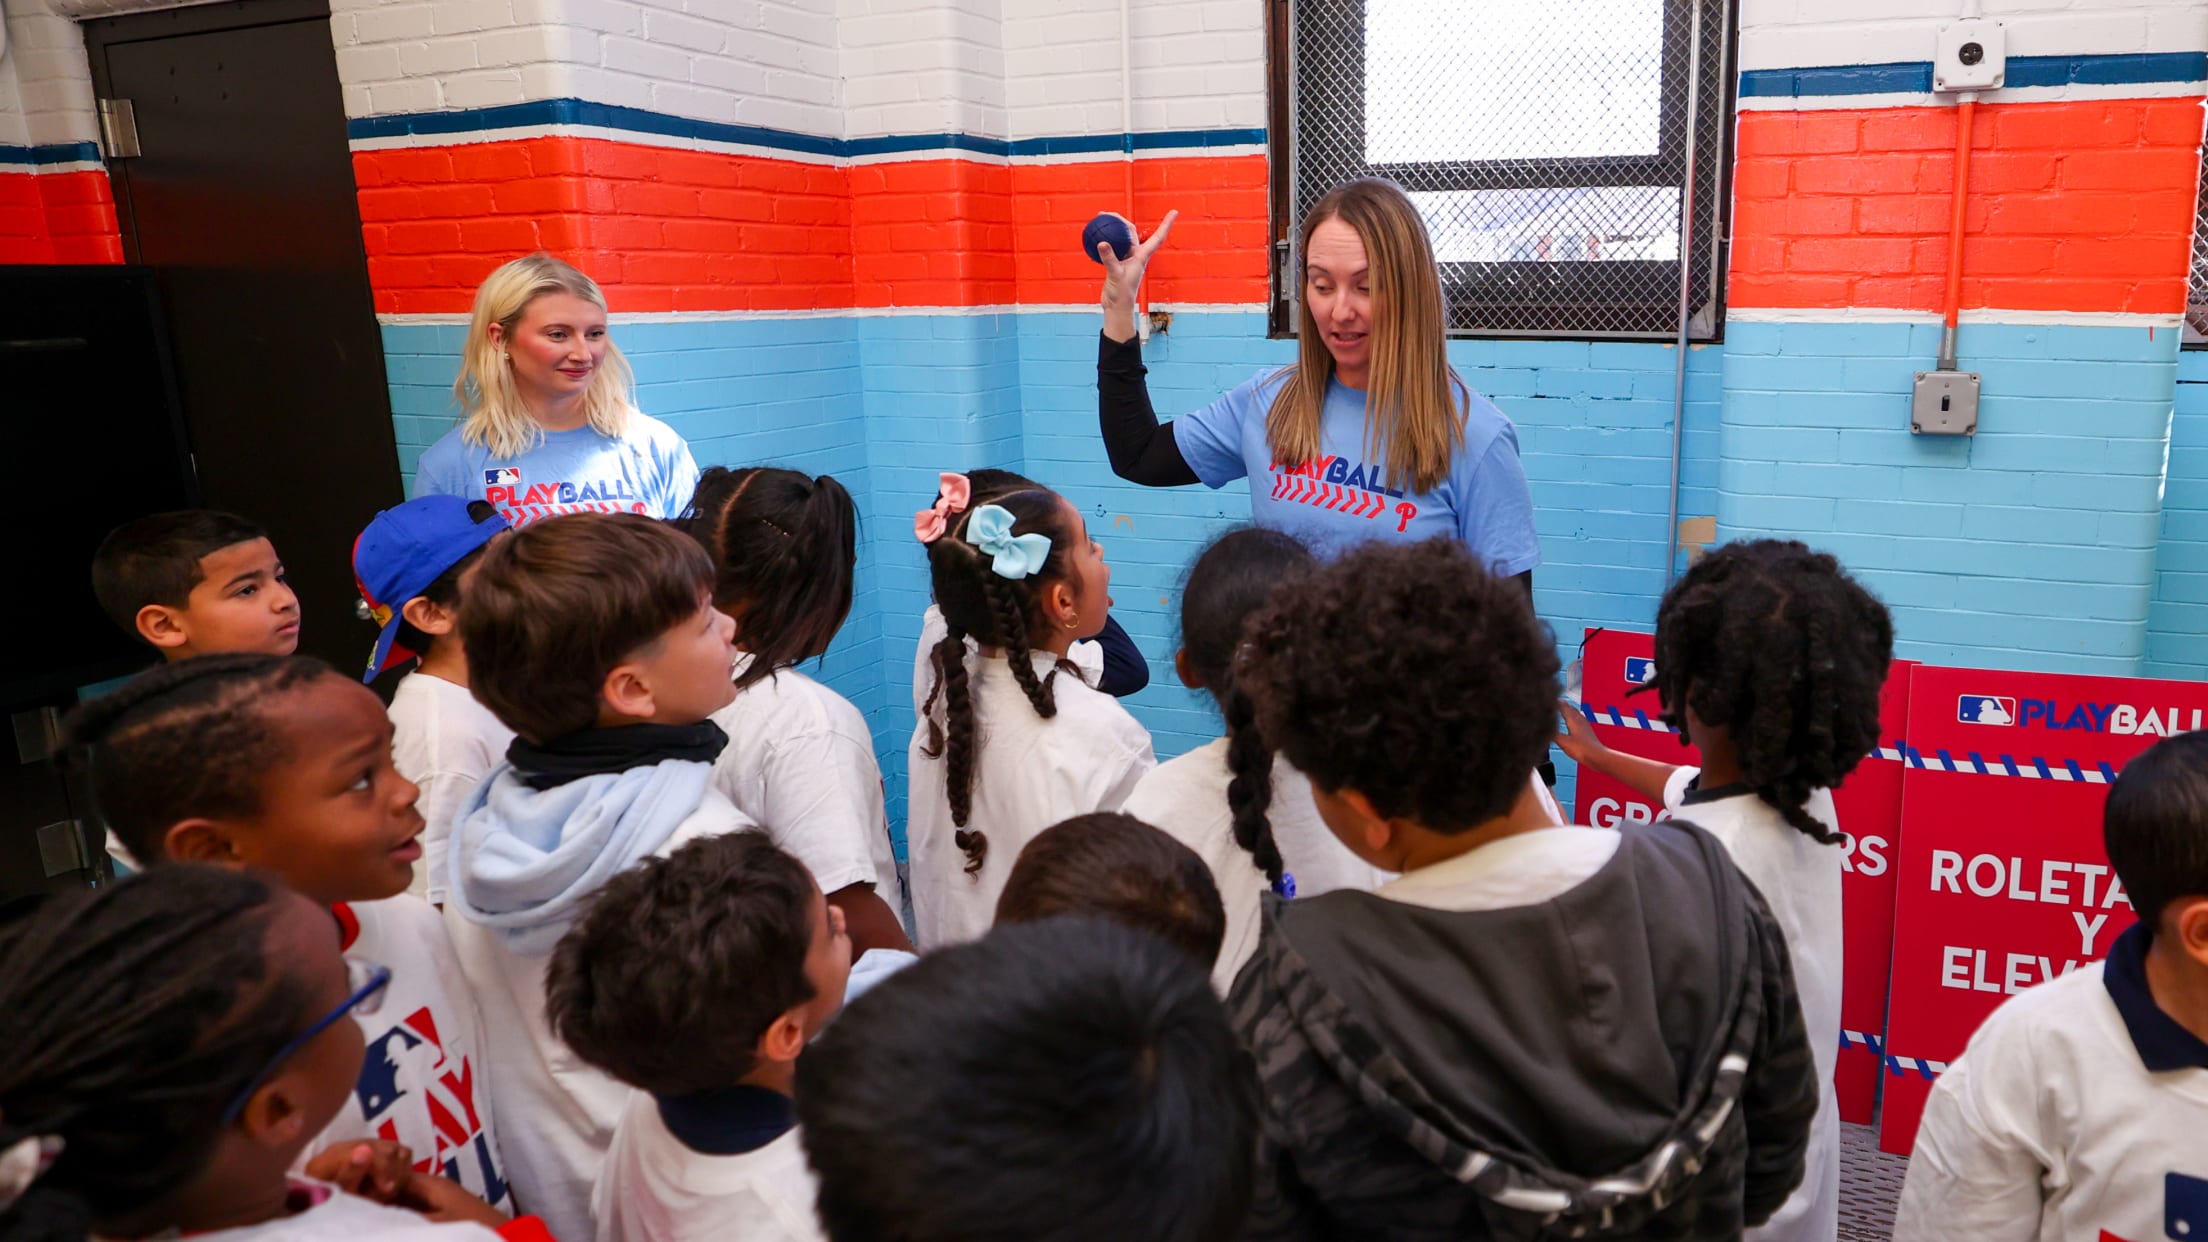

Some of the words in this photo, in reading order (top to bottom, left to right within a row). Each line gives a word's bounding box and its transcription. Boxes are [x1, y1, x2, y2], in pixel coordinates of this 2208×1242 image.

[486, 480, 633, 508] PLAYBALL
[1930, 849, 2136, 911] ROLETA
[2072, 911, 2108, 956] Y
[1941, 945, 2096, 995] ELEV
